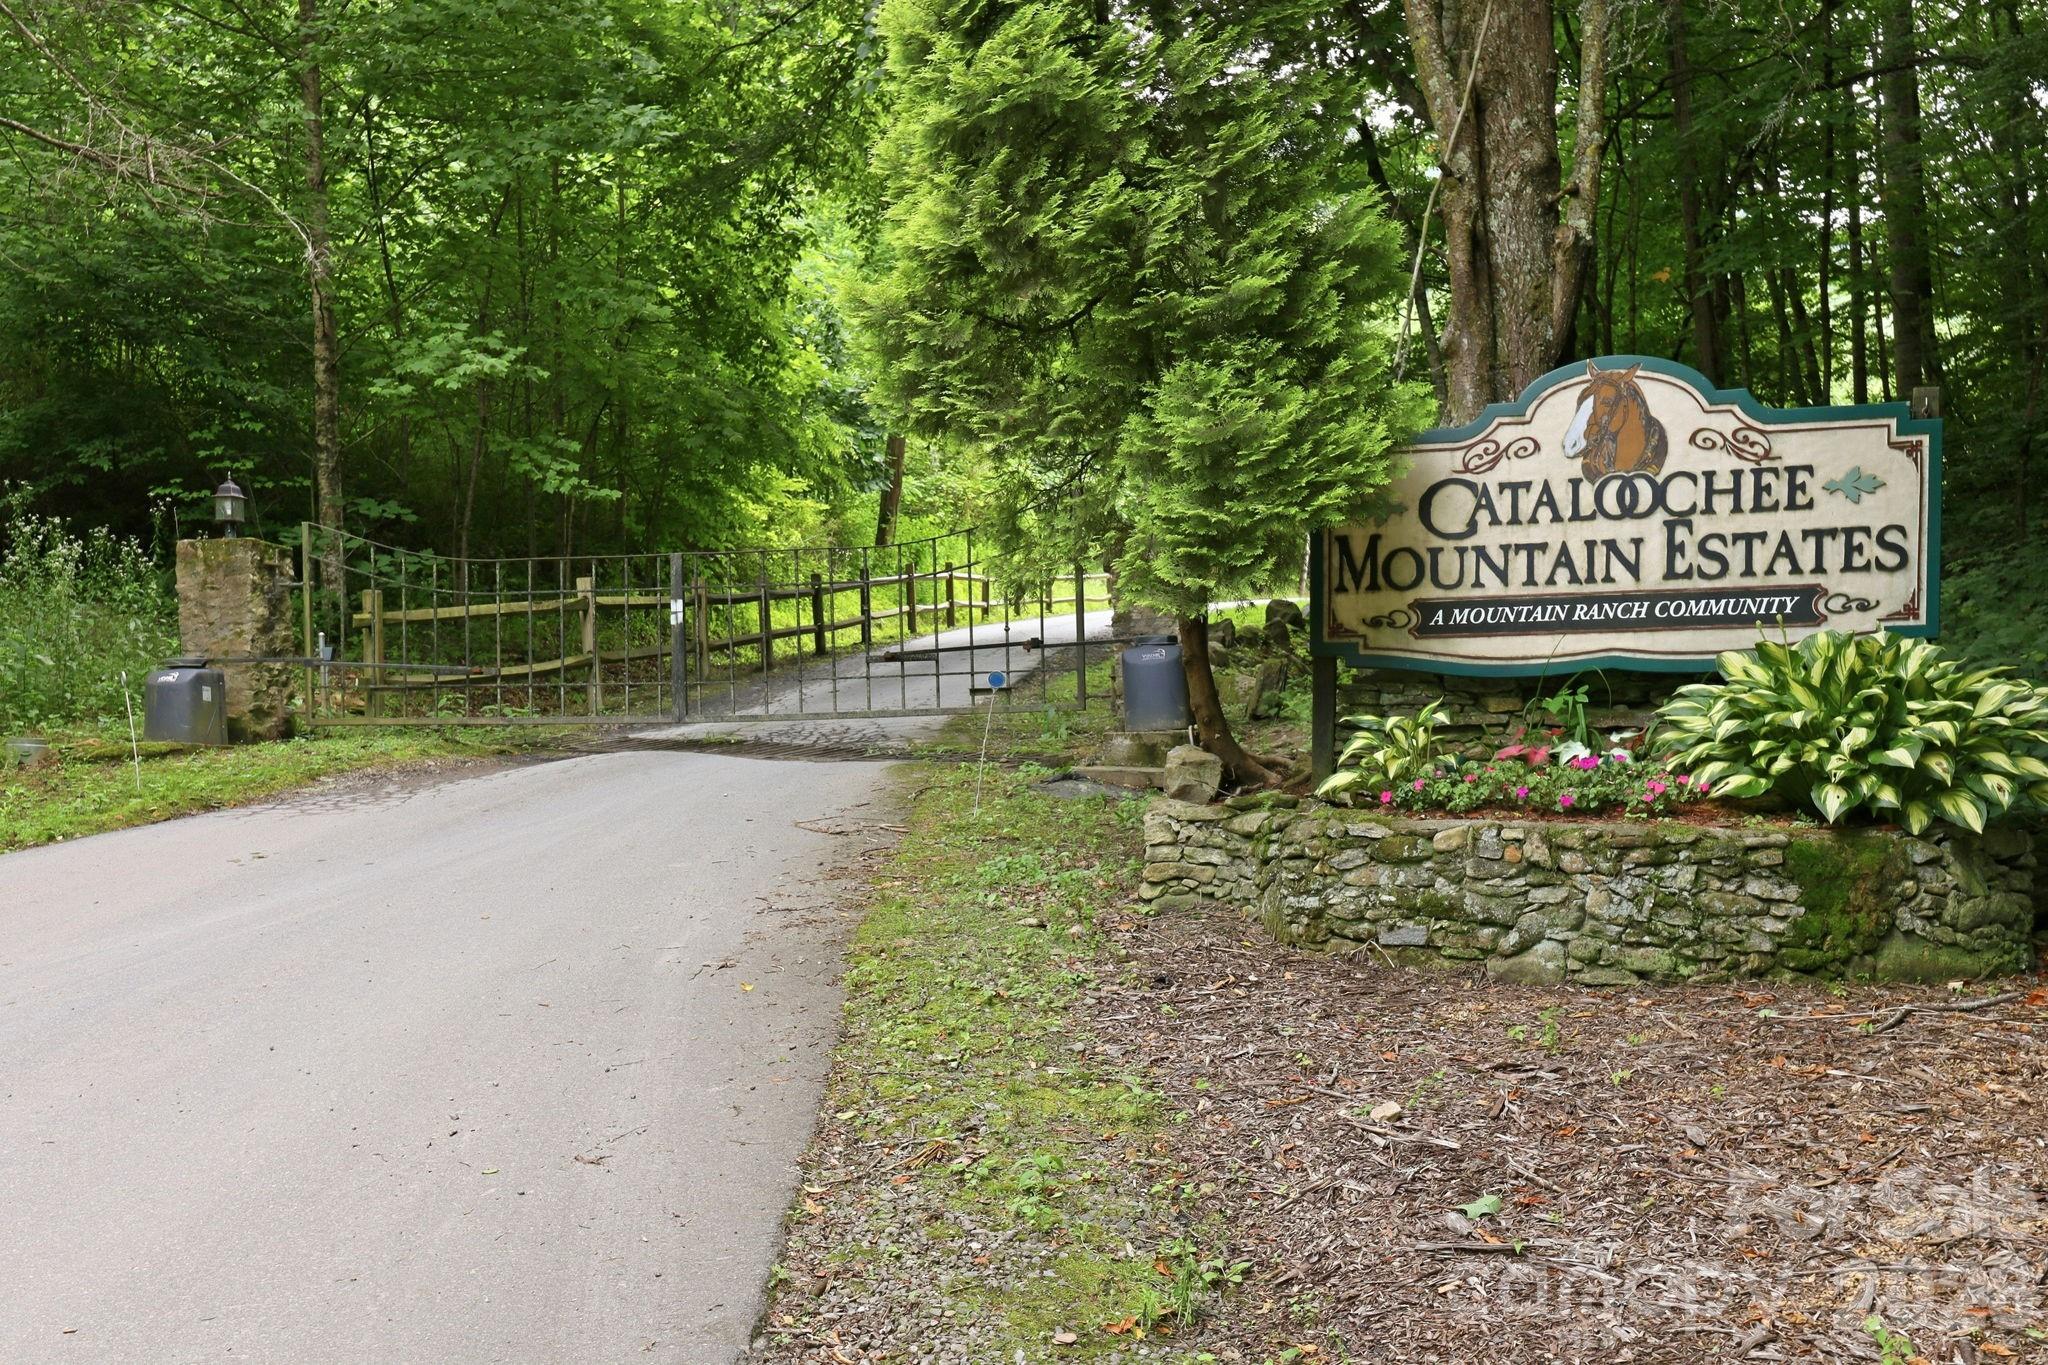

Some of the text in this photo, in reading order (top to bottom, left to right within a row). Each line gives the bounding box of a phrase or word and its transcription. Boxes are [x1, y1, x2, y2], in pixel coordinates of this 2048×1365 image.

[1418, 464, 1814, 540] CATALOOCHEE
[1334, 518, 1909, 593] MOUNTAIN ESTATES
[1429, 596, 1800, 626] A MOUNTAIN RANCH COMMUNITY
